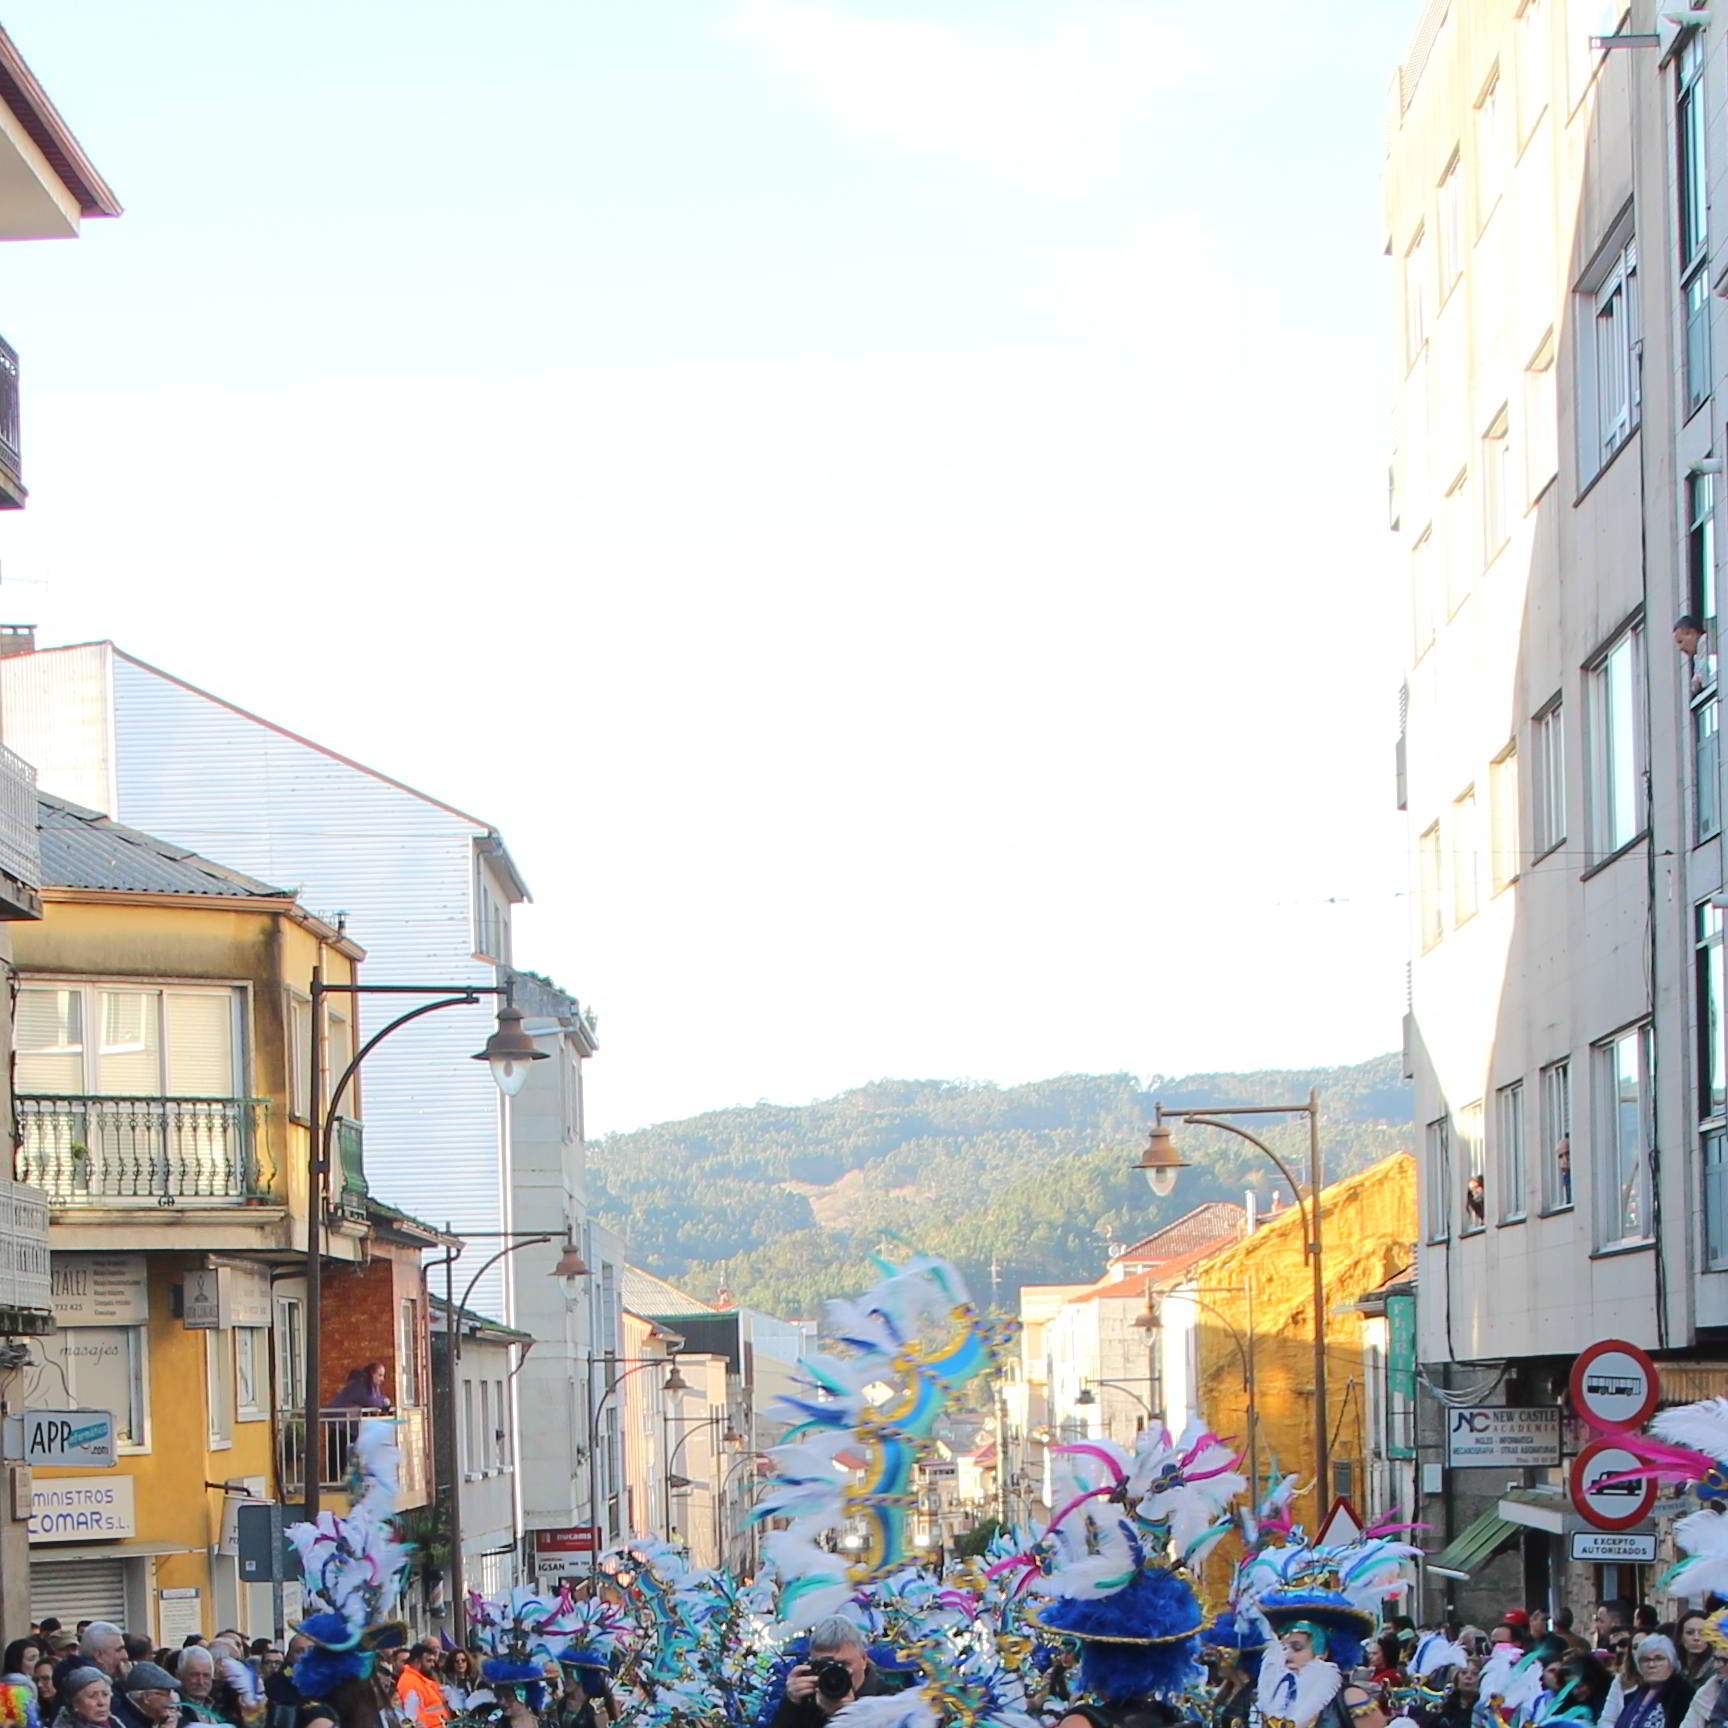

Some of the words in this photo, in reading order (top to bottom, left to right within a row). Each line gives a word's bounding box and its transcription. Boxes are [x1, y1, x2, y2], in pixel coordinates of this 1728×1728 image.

[60, 1342, 120, 1366] masajes
[1493, 1411, 1514, 1422] NEW
[1519, 1410, 1558, 1422] CASTLE
[1493, 1423, 1558, 1433] ACADEMIA
[30, 1420, 72, 1454] APP
[32, 1489, 114, 1507] MINISTROS
[1593, 1537, 1636, 1546] EXCEPTO
[1581, 1546, 1648, 1556] AUTORIZADOS
